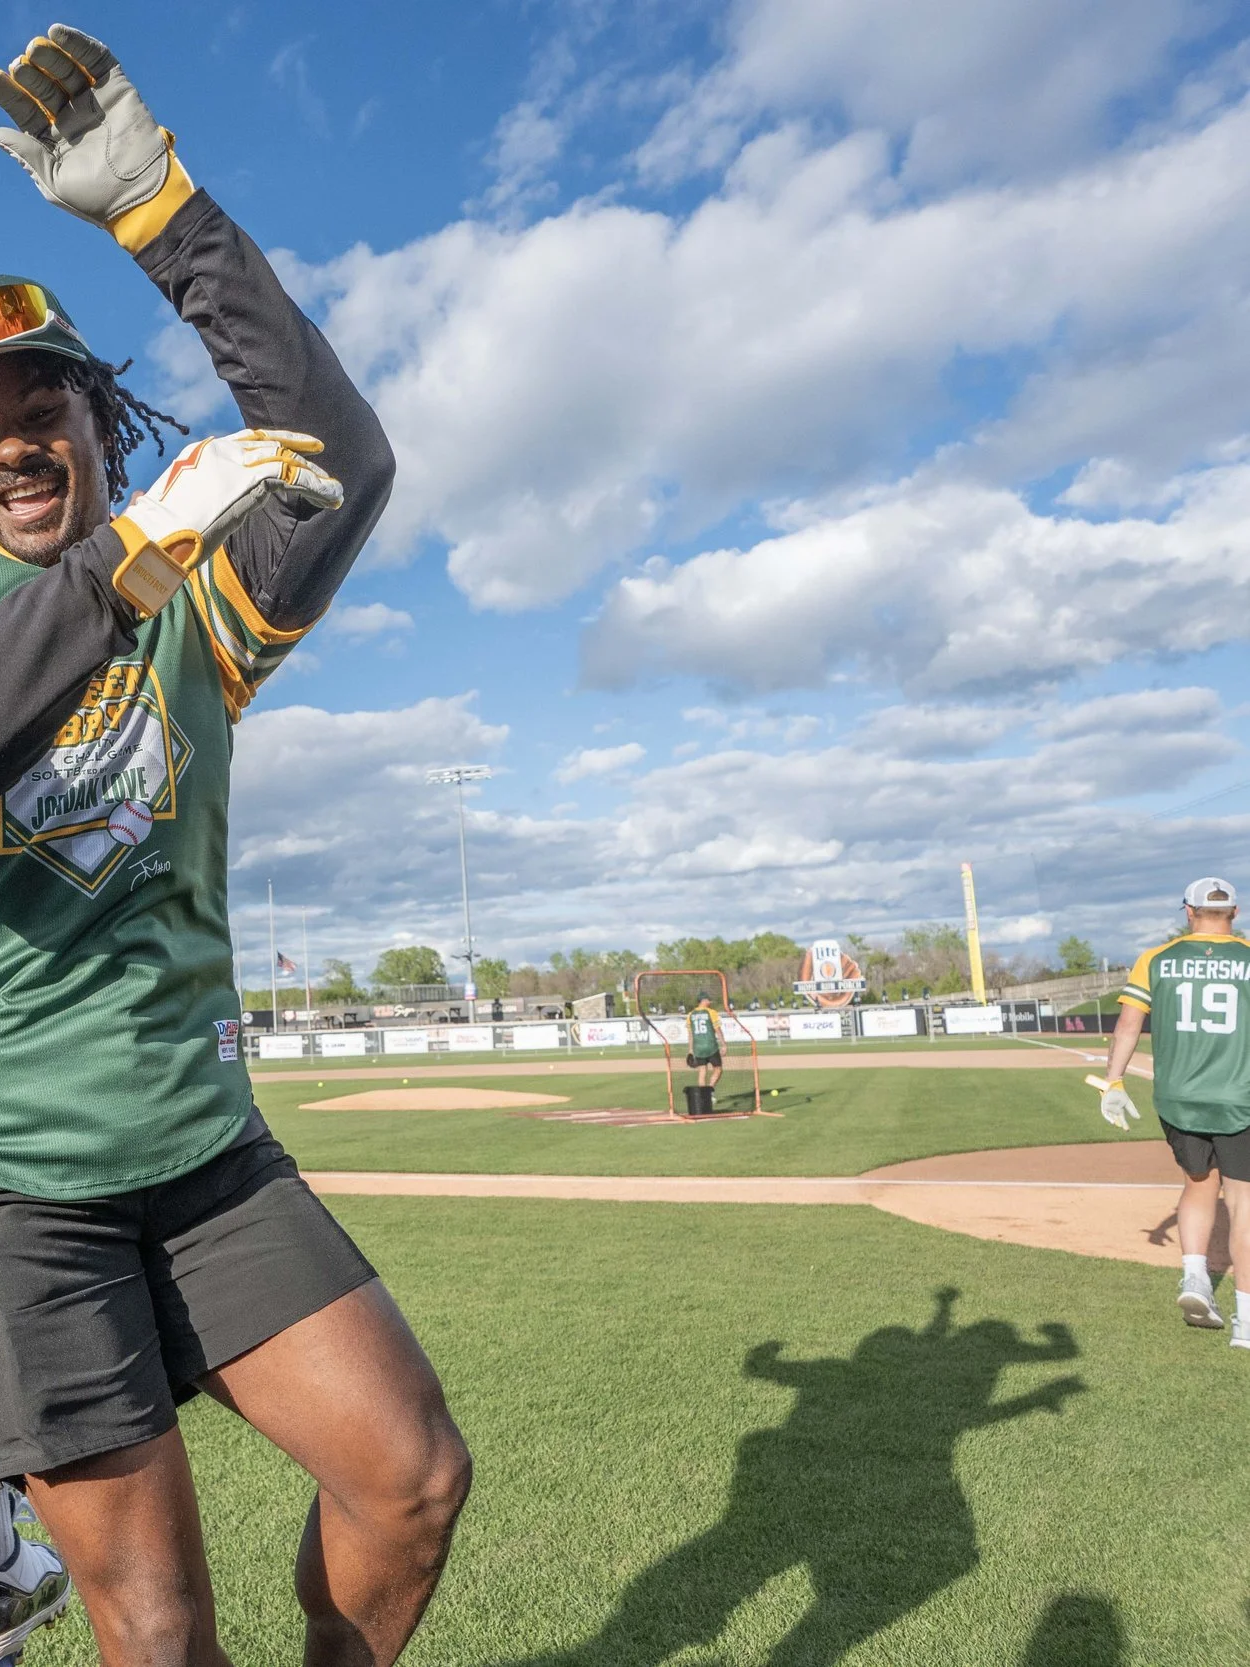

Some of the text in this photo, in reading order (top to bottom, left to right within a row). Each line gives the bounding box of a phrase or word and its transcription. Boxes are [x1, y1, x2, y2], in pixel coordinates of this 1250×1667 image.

[107, 743, 144, 760] GAME
[31, 766, 150, 830] JORDAN LOVE
[1176, 982, 1238, 1034] 19
[694, 1020, 707, 1034] 16
